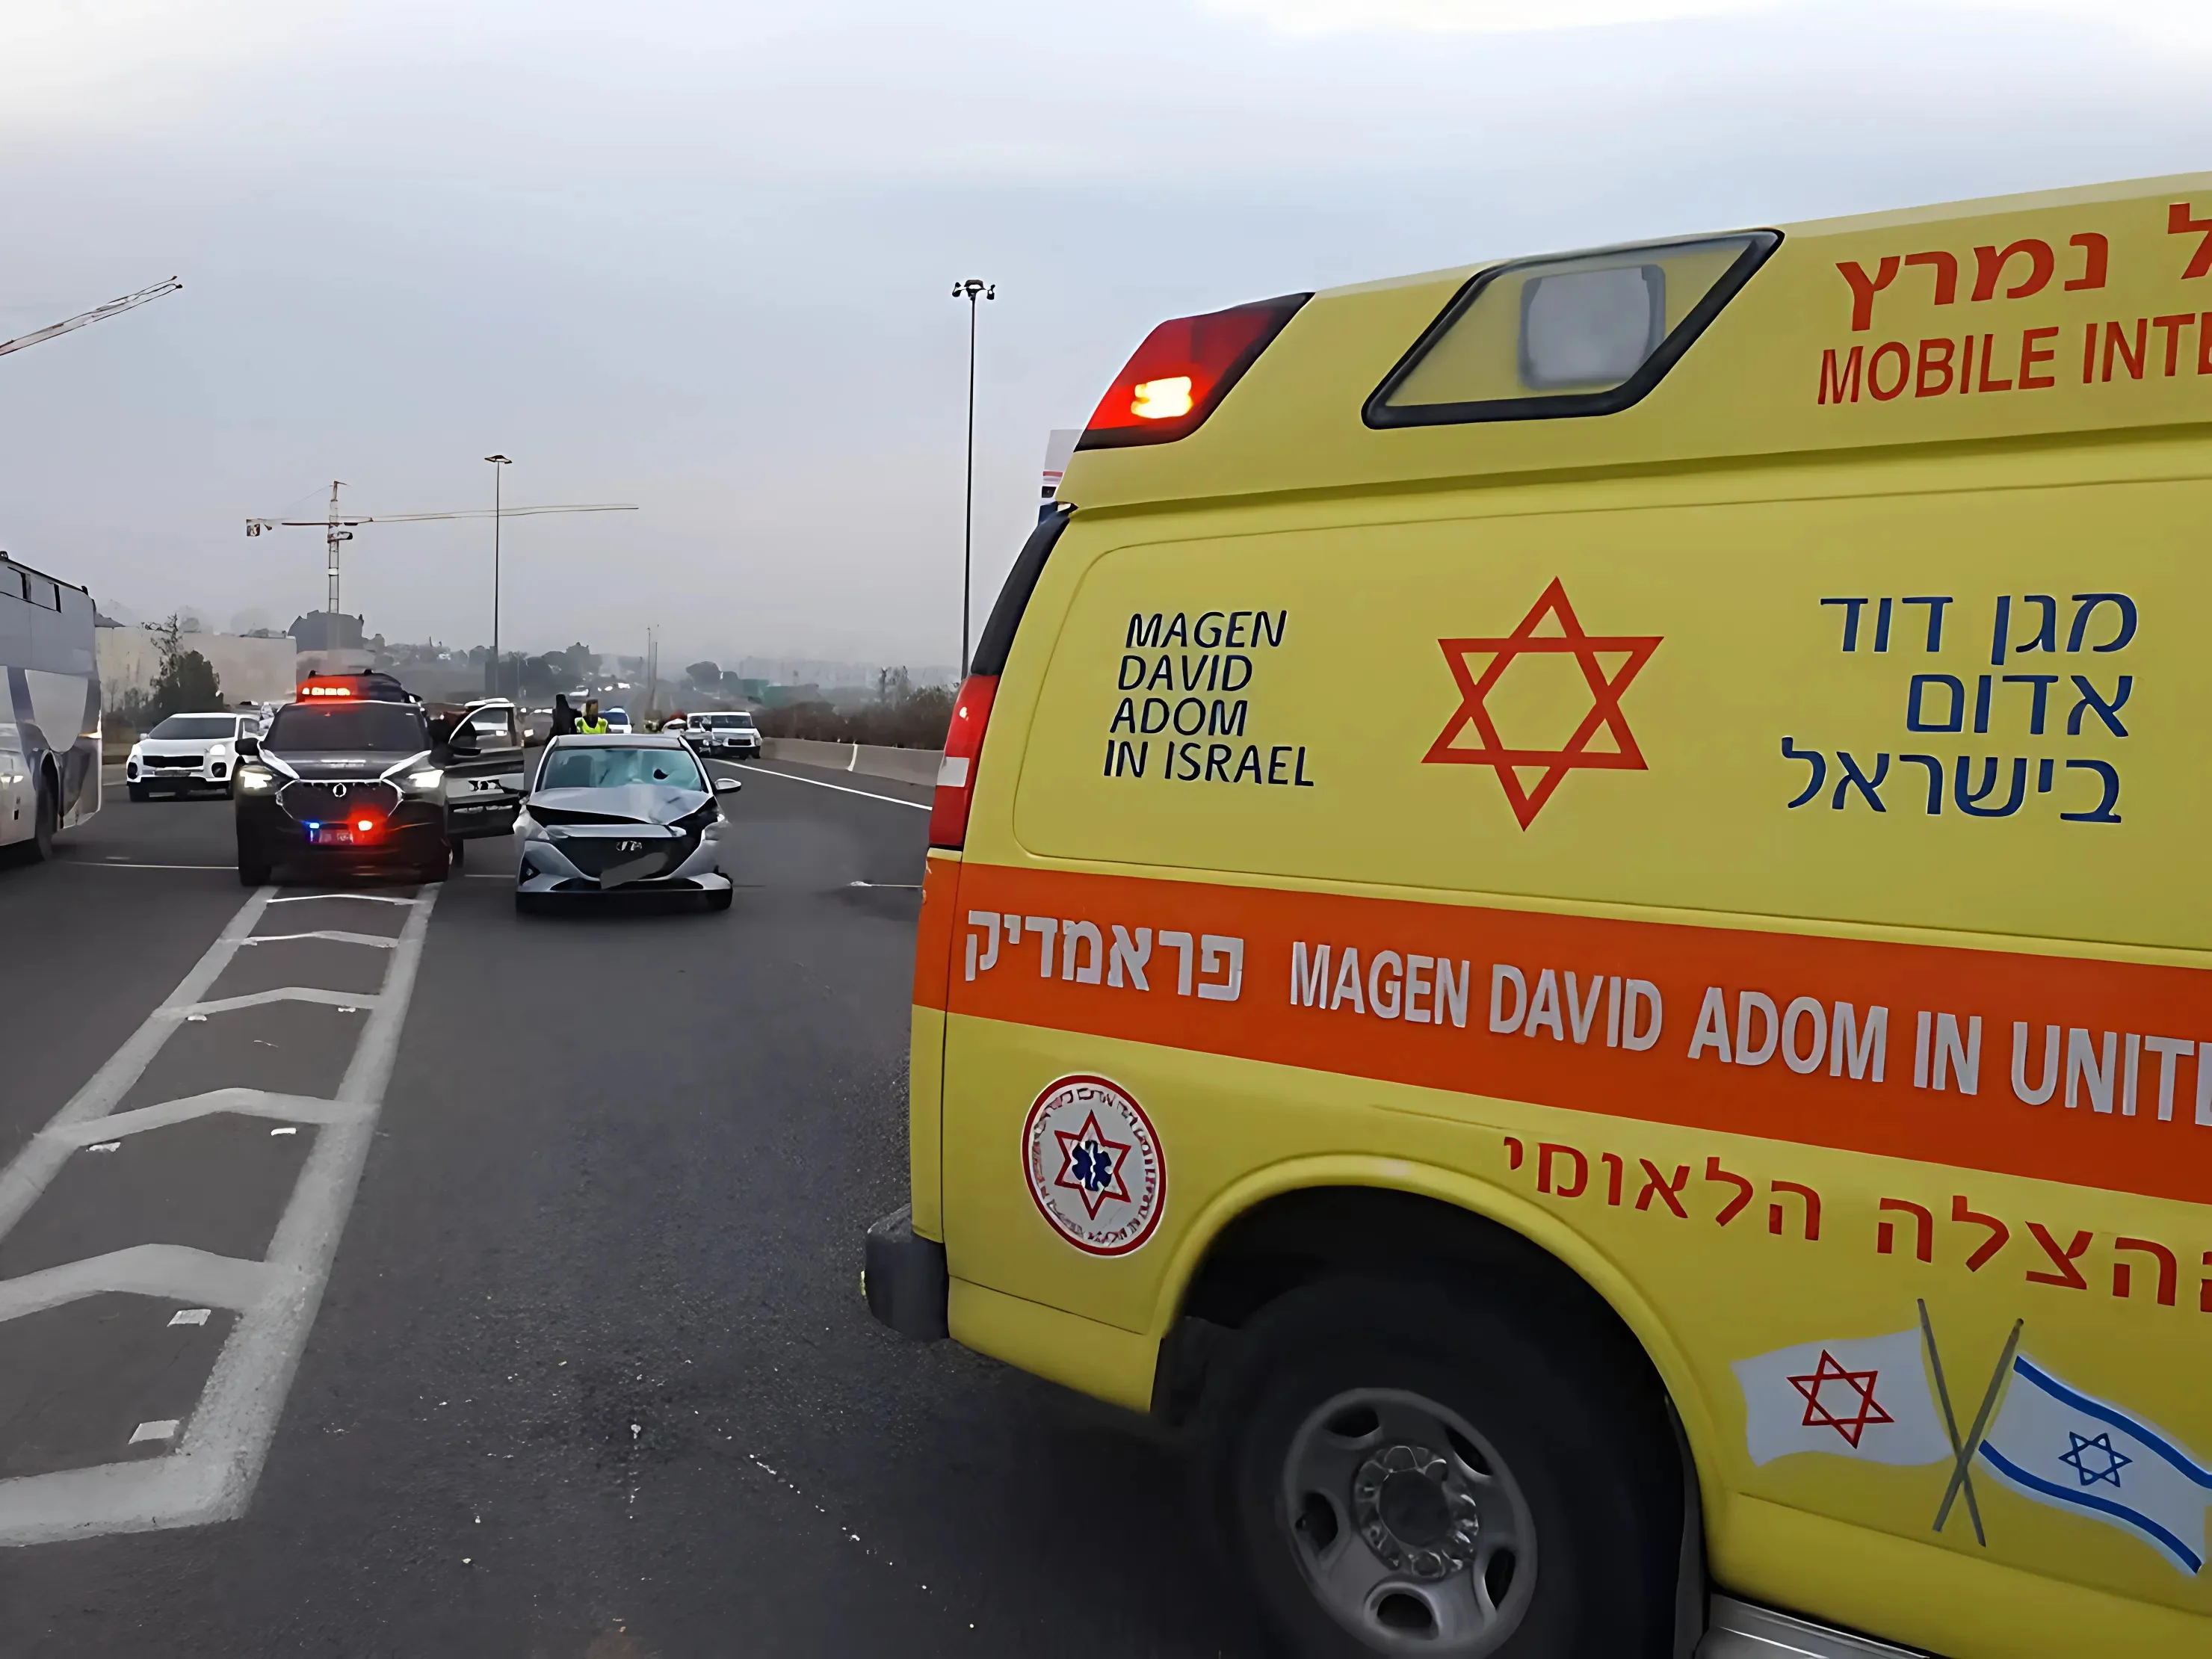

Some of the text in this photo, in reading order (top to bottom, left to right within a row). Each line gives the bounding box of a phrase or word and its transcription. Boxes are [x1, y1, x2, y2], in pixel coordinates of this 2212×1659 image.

[1835, 232, 2109, 332] נמרץ
[1817, 326, 2059, 405] MOBILE
[1125, 610, 1287, 648] MAGEN
[1820, 593, 2137, 666] מגן דוד
[1118, 655, 1252, 691] DAVID
[1906, 674, 2134, 737] אדום
[1110, 697, 1247, 736] ADOM
[1104, 739, 1314, 787] IN ISRAEL
[1782, 736, 2122, 824] בישראל
[965, 910, 1244, 1001] פראמדיק
[1290, 942, 1470, 1028] MAGEN
[1489, 963, 1663, 1051] DAVID
[1687, 986, 1888, 1082] ADOM
[1913, 1010, 1982, 1095] IN
[1504, 1136, 2212, 1313] הצלה הלאומי
